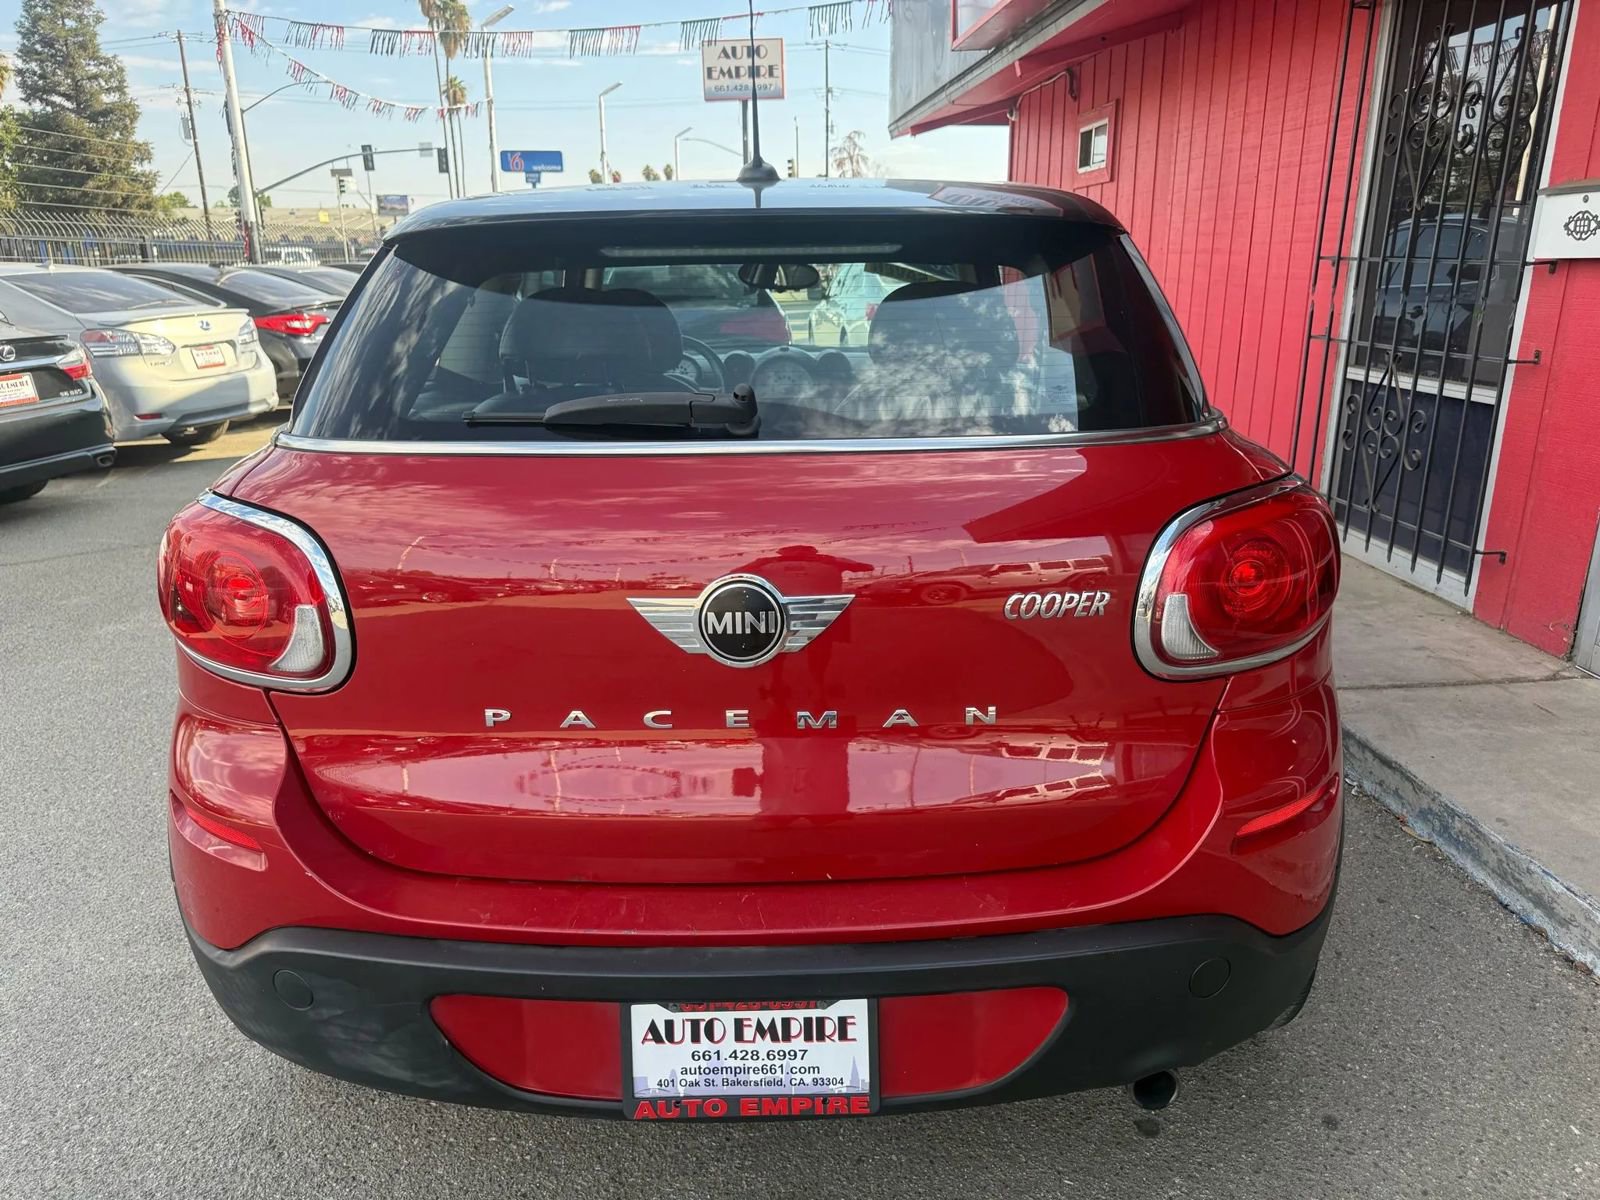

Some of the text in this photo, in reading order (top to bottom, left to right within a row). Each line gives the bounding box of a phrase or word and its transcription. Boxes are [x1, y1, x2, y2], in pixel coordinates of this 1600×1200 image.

[717, 44, 768, 60] AUTO
[706, 64, 780, 80] EMPIRE
[1003, 590, 1111, 620] COOPER
[706, 611, 776, 635] MINI
[484, 706, 996, 729] PACEMAN
[641, 1016, 858, 1045] AUTO EMPIRE
[691, 1049, 808, 1062] 661.428.6997
[680, 1063, 821, 1077] autoempire661.com
[657, 1077, 844, 1088] 401 Oak St. Bakersfield, CA. 93304
[634, 1095, 870, 1120] AUTO EMPIRE
